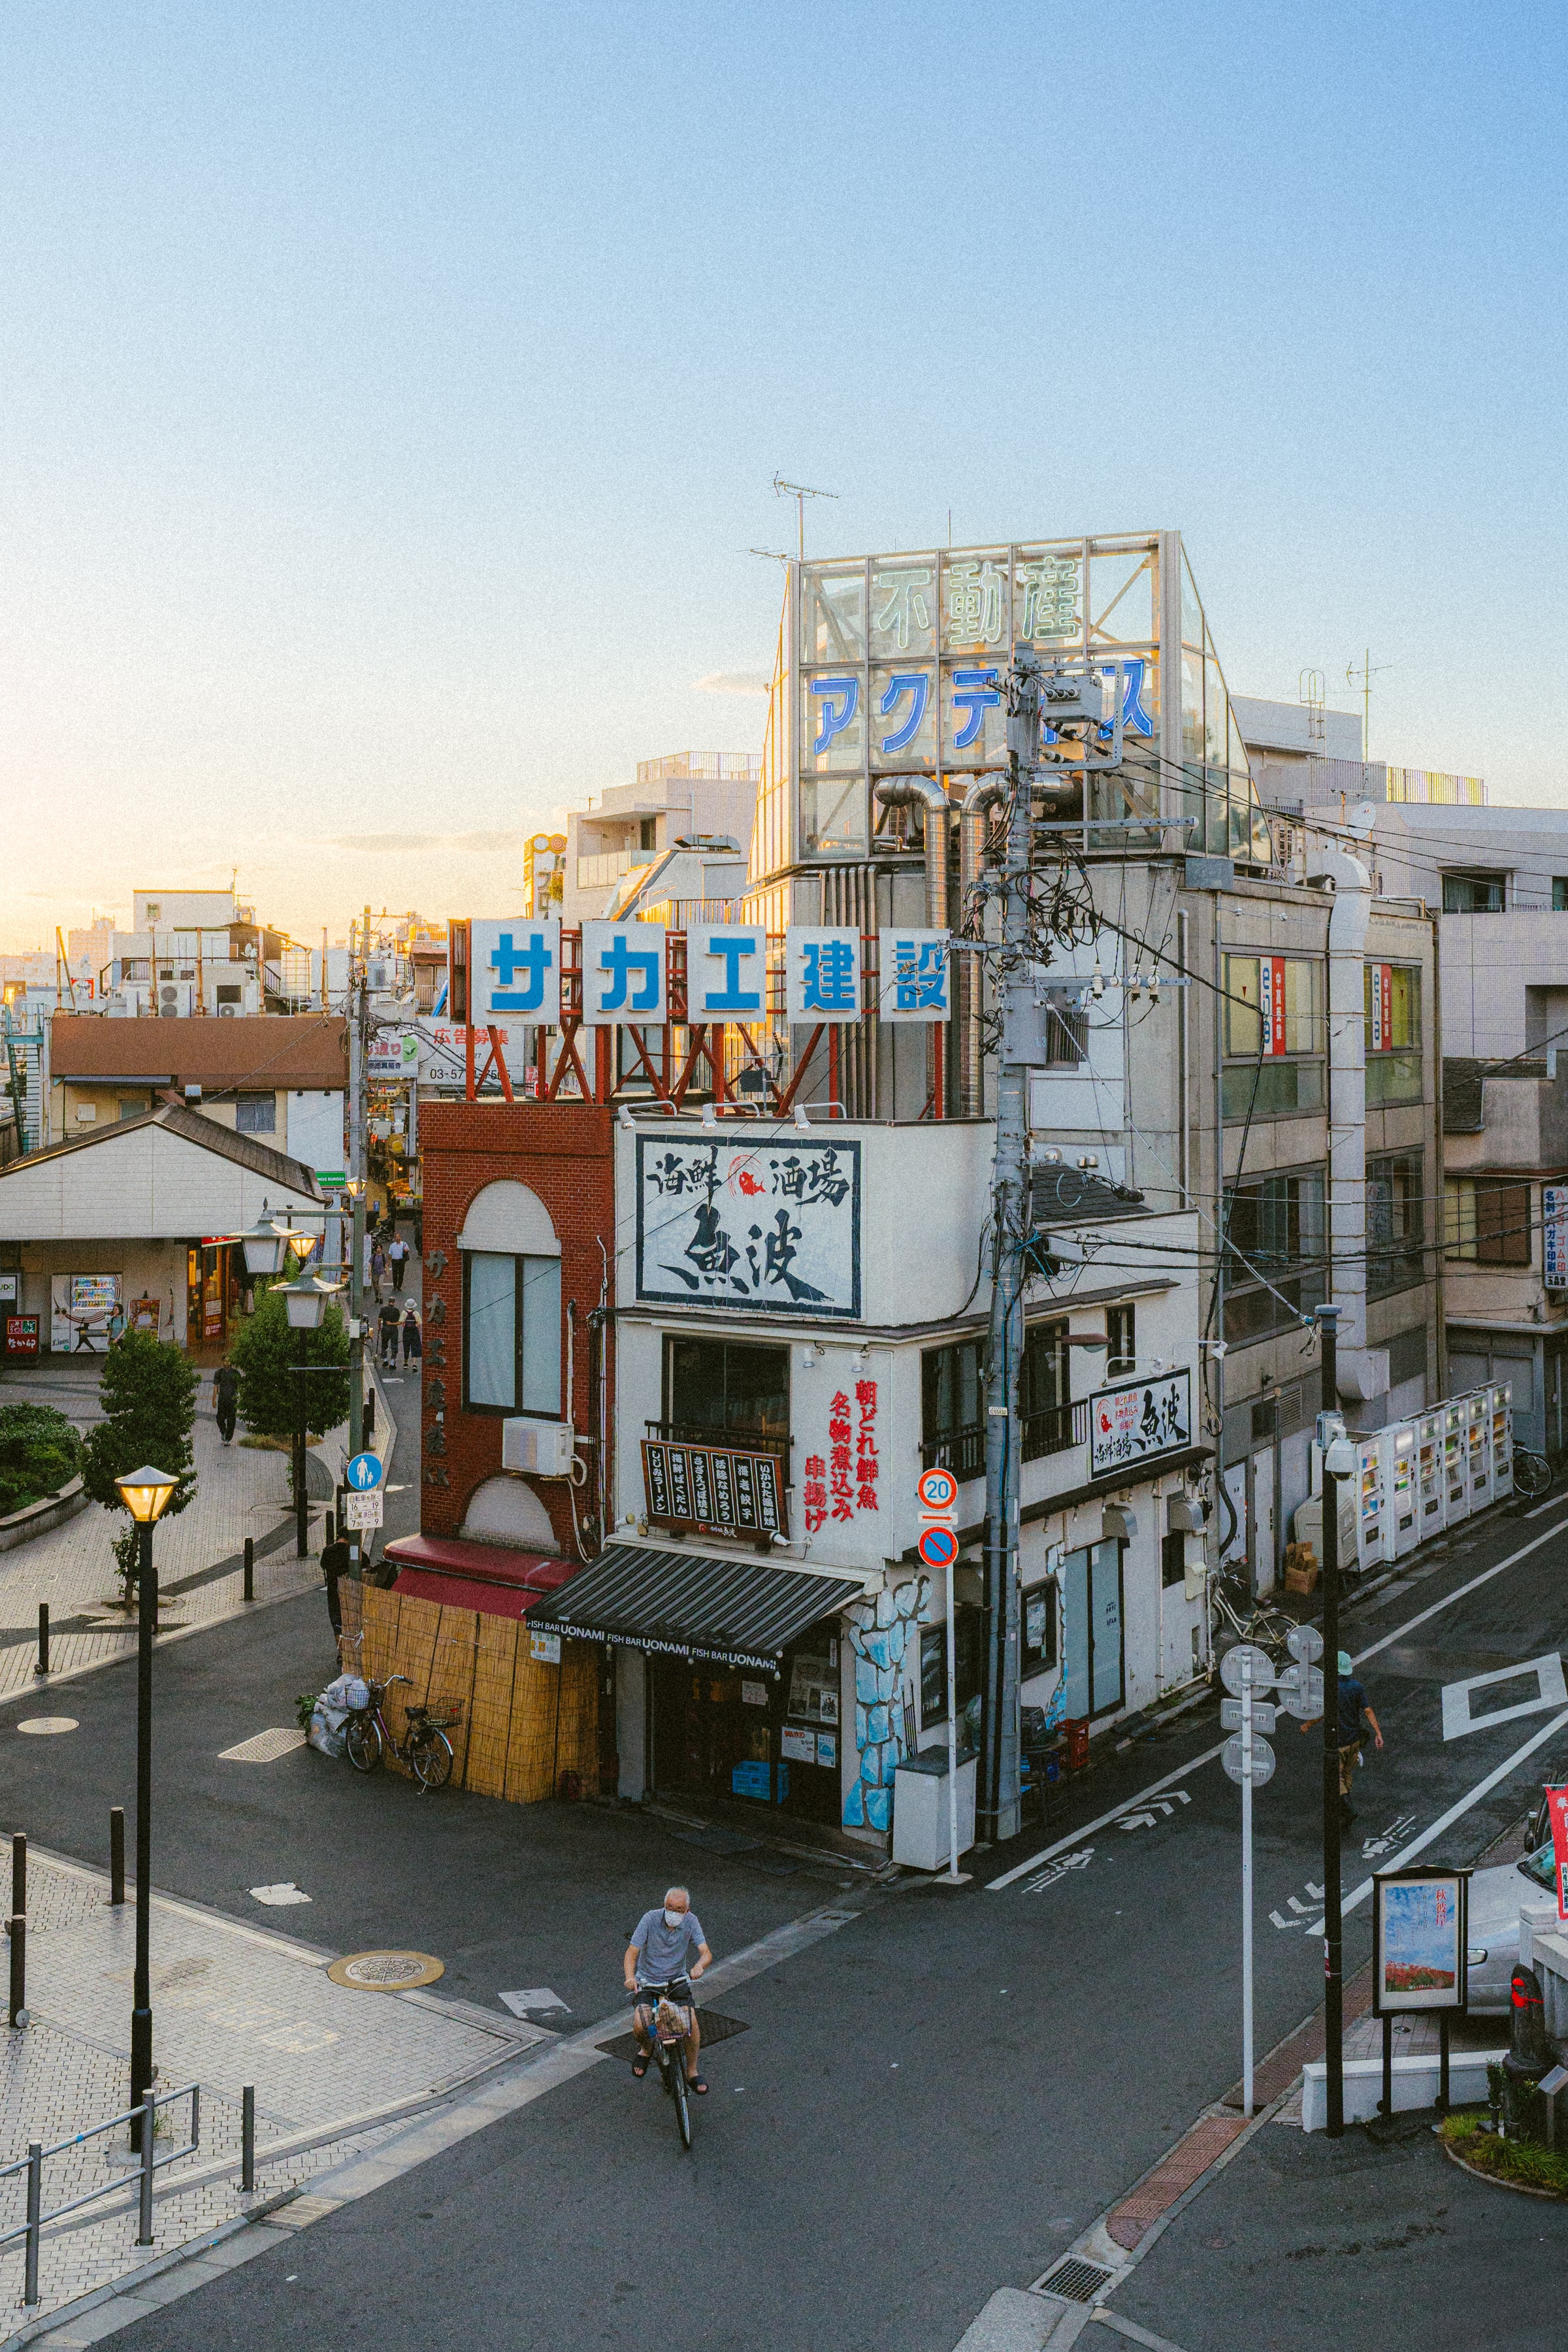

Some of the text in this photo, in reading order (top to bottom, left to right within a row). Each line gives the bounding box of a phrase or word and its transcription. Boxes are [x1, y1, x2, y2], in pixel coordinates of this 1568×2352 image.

[878, 555, 1078, 649] 不動産
[811, 659, 1152, 755] アクテス
[491, 934, 947, 1010] サカエ建設
[646, 1145, 850, 1215] 海鮮 酒場
[657, 1203, 835, 1302] 魚波
[8, 1338, 36, 1348] なか卯
[1115, 1392, 1137, 1406] 朝どれ鮮魚
[1115, 1407, 1139, 1420] 名物煮込み
[1131, 1383, 1188, 1451] 魚波
[828, 1390, 854, 1522] 名物煮込み
[855, 1379, 879, 1511] 朝どれ鮮魚
[652, 1450, 666, 1511] しじみラーメン
[803, 1454, 828, 1533] 串揚げ
[926, 1480, 949, 1499] 20
[545, 1622, 560, 1632] BAR
[561, 1624, 604, 1641] UONAMI
[607, 1634, 624, 1644] FISH
[626, 1637, 642, 1646] BAR
[643, 1640, 689, 1656] UONAMI
[693, 1648, 710, 1658] FISH
[711, 1651, 728, 1661] BAR
[728, 1653, 776, 1670] UONAMI
[1436, 1889, 1446, 1927] 秋彼岸
